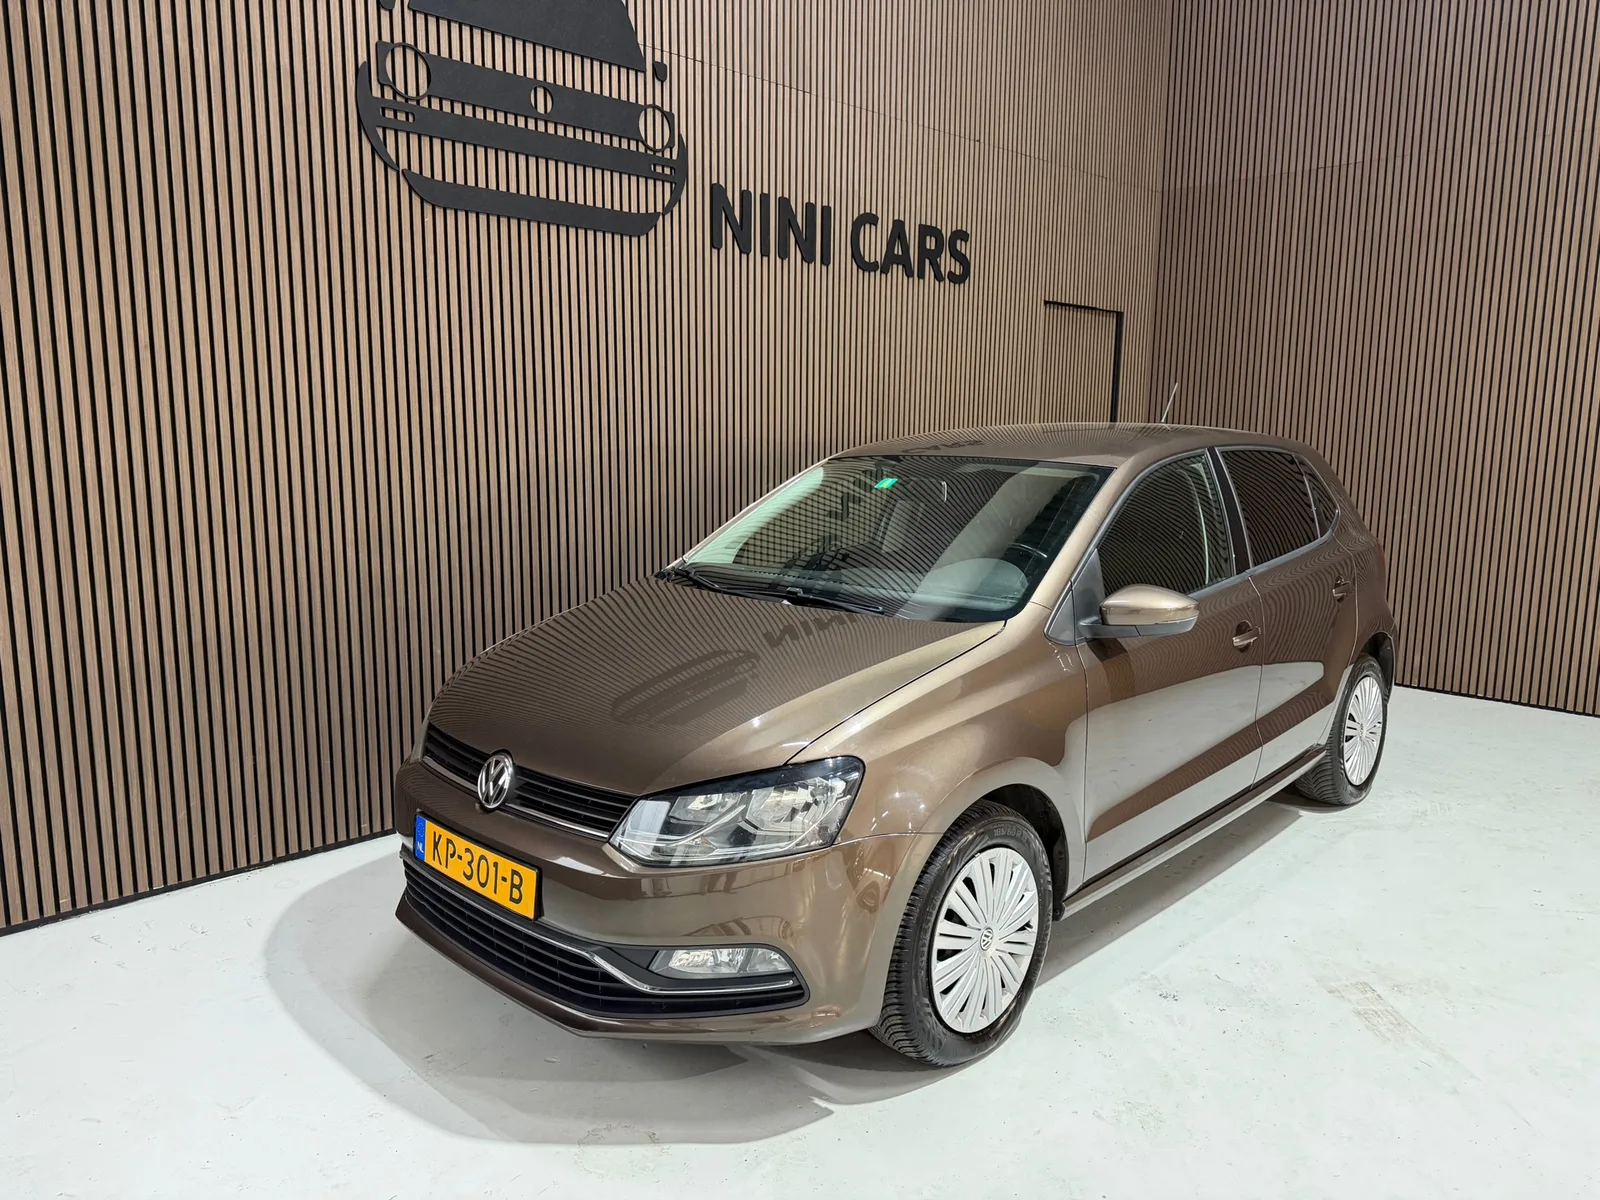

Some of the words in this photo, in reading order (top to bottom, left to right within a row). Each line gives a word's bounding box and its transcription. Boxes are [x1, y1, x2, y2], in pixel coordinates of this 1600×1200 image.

[710, 183, 832, 266] NINI
[851, 212, 970, 285] CARS
[432, 831, 524, 905] KP-301-B
